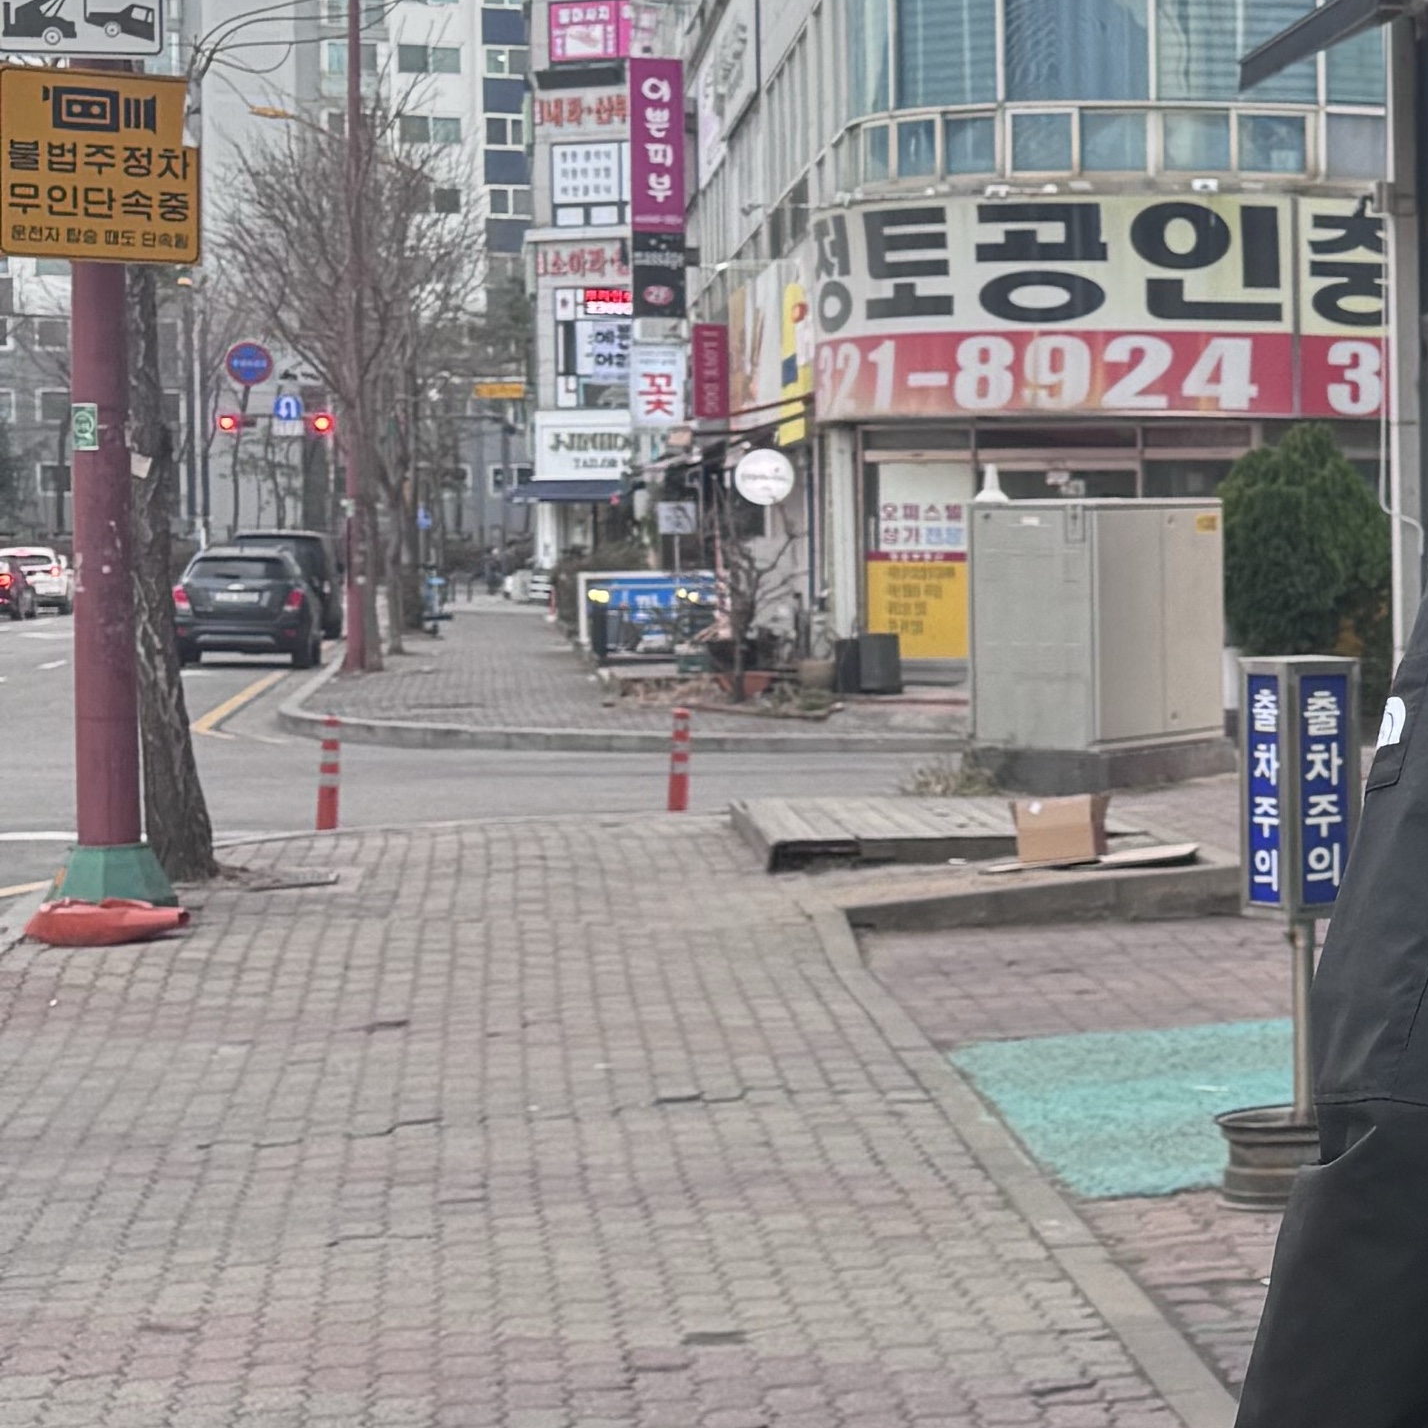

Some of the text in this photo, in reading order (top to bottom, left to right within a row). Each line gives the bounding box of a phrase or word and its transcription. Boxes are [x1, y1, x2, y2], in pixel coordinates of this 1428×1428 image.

[9, 139, 190, 180] 불법주정차
[9, 183, 190, 222] 무인단속중
[12, 225, 60, 243] 운전자
[638, 373, 677, 416] 꽃
[817, 335, 1258, 418] 321-8924
[883, 503, 962, 522] 오피스텔
[1252, 688, 1279, 891] 출차주의
[1303, 690, 1343, 887] 출차주의
